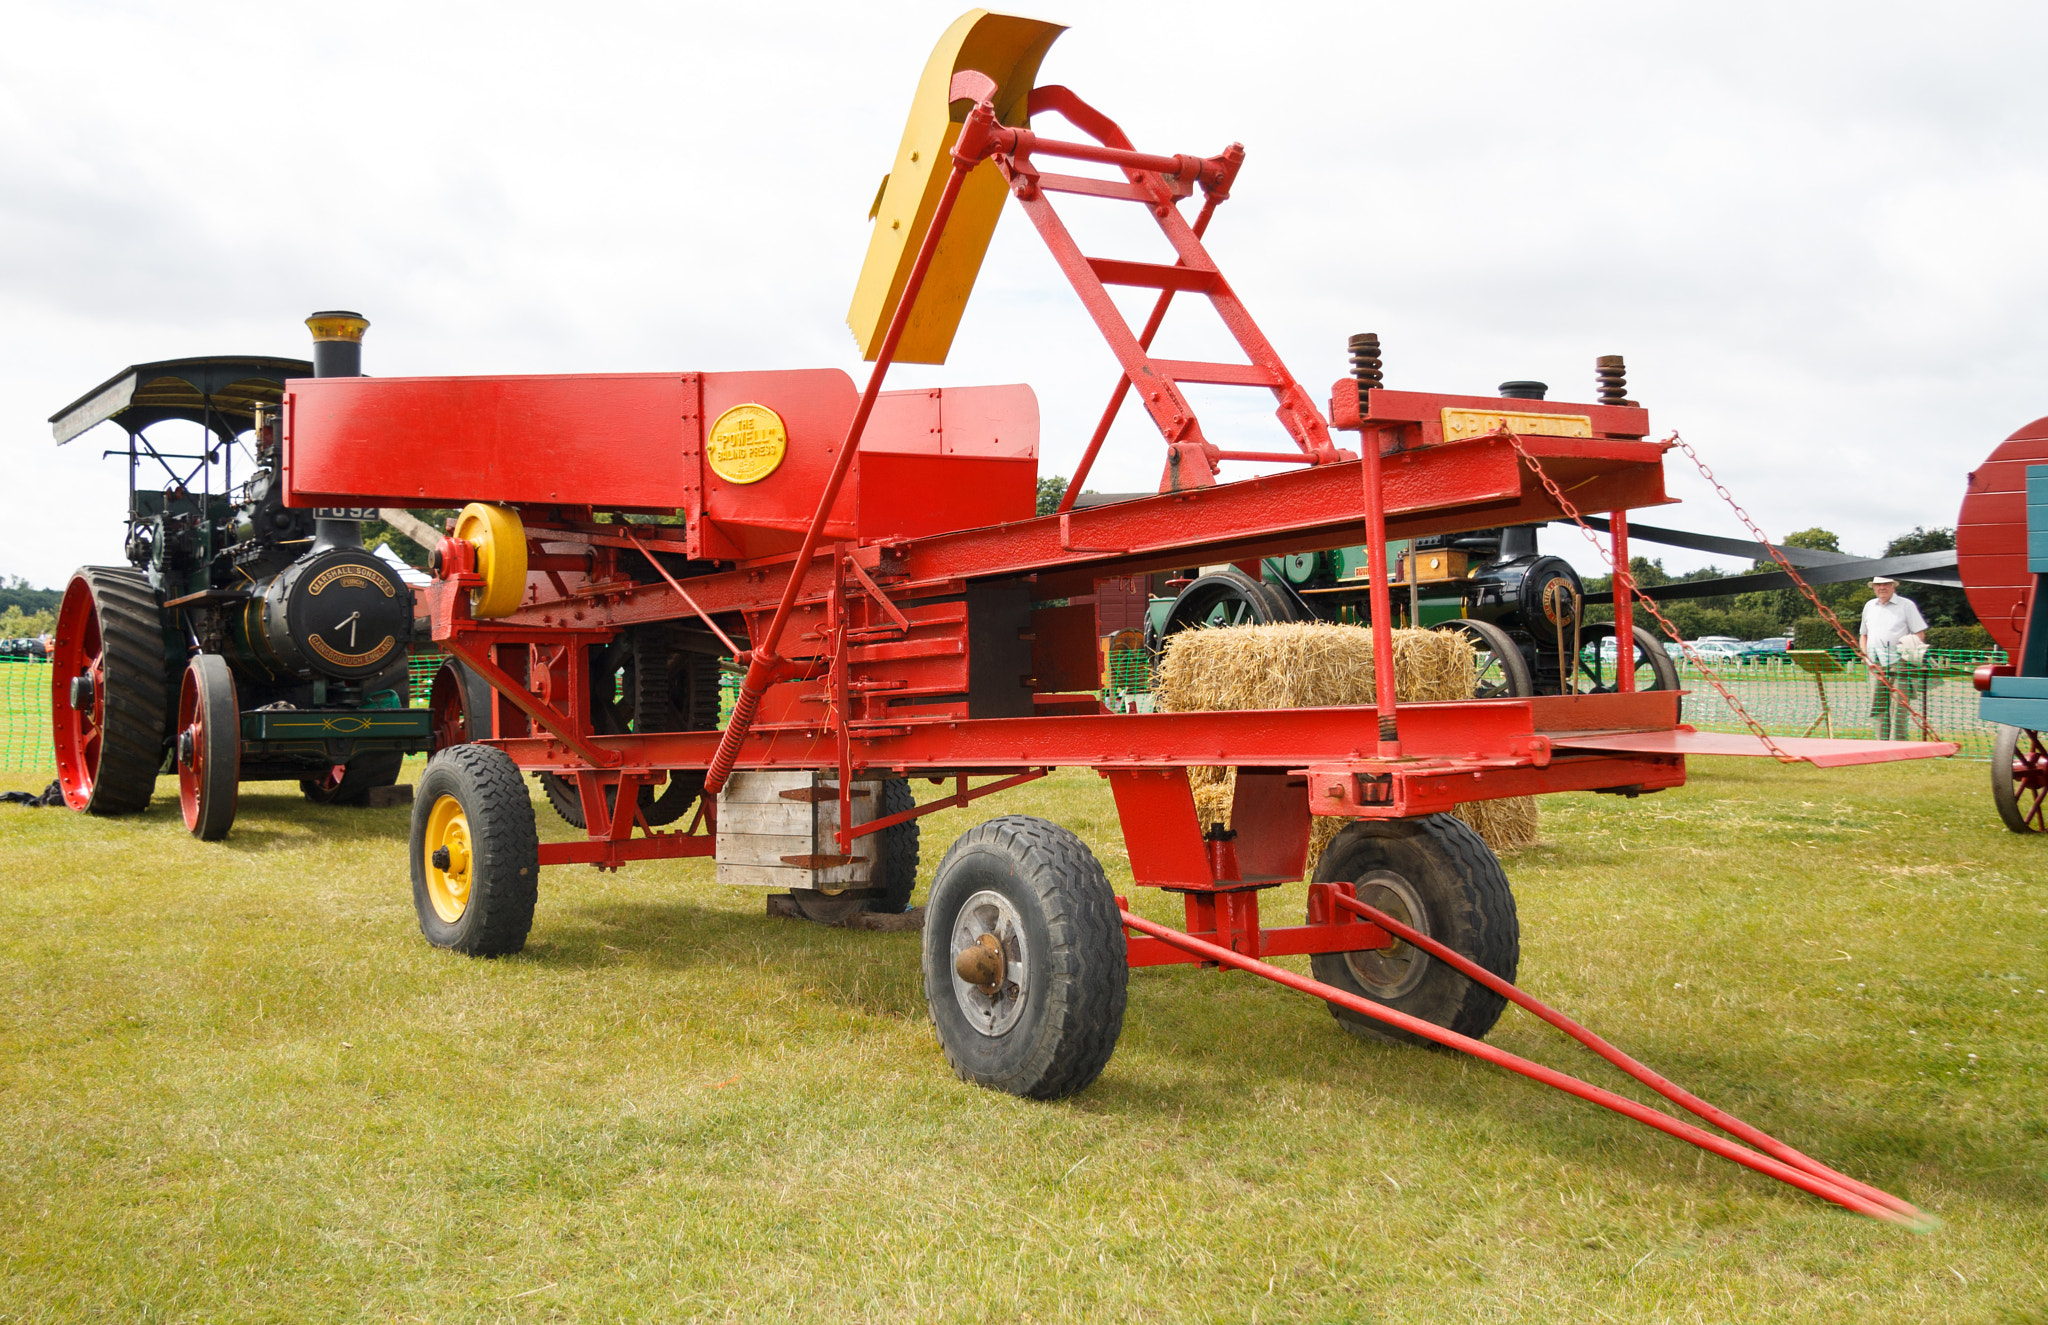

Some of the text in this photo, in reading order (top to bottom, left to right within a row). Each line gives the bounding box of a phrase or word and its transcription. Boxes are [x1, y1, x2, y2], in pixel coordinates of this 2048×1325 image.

[737, 418, 754, 431] THE
[717, 428, 776, 450] "POWELL"
[717, 444, 777, 462] BALING PRESS
[311, 566, 353, 591] MARSHALL
[356, 567, 376, 580] SONS
[311, 636, 394, 665] GAINSBOROUGH ENGLAND
